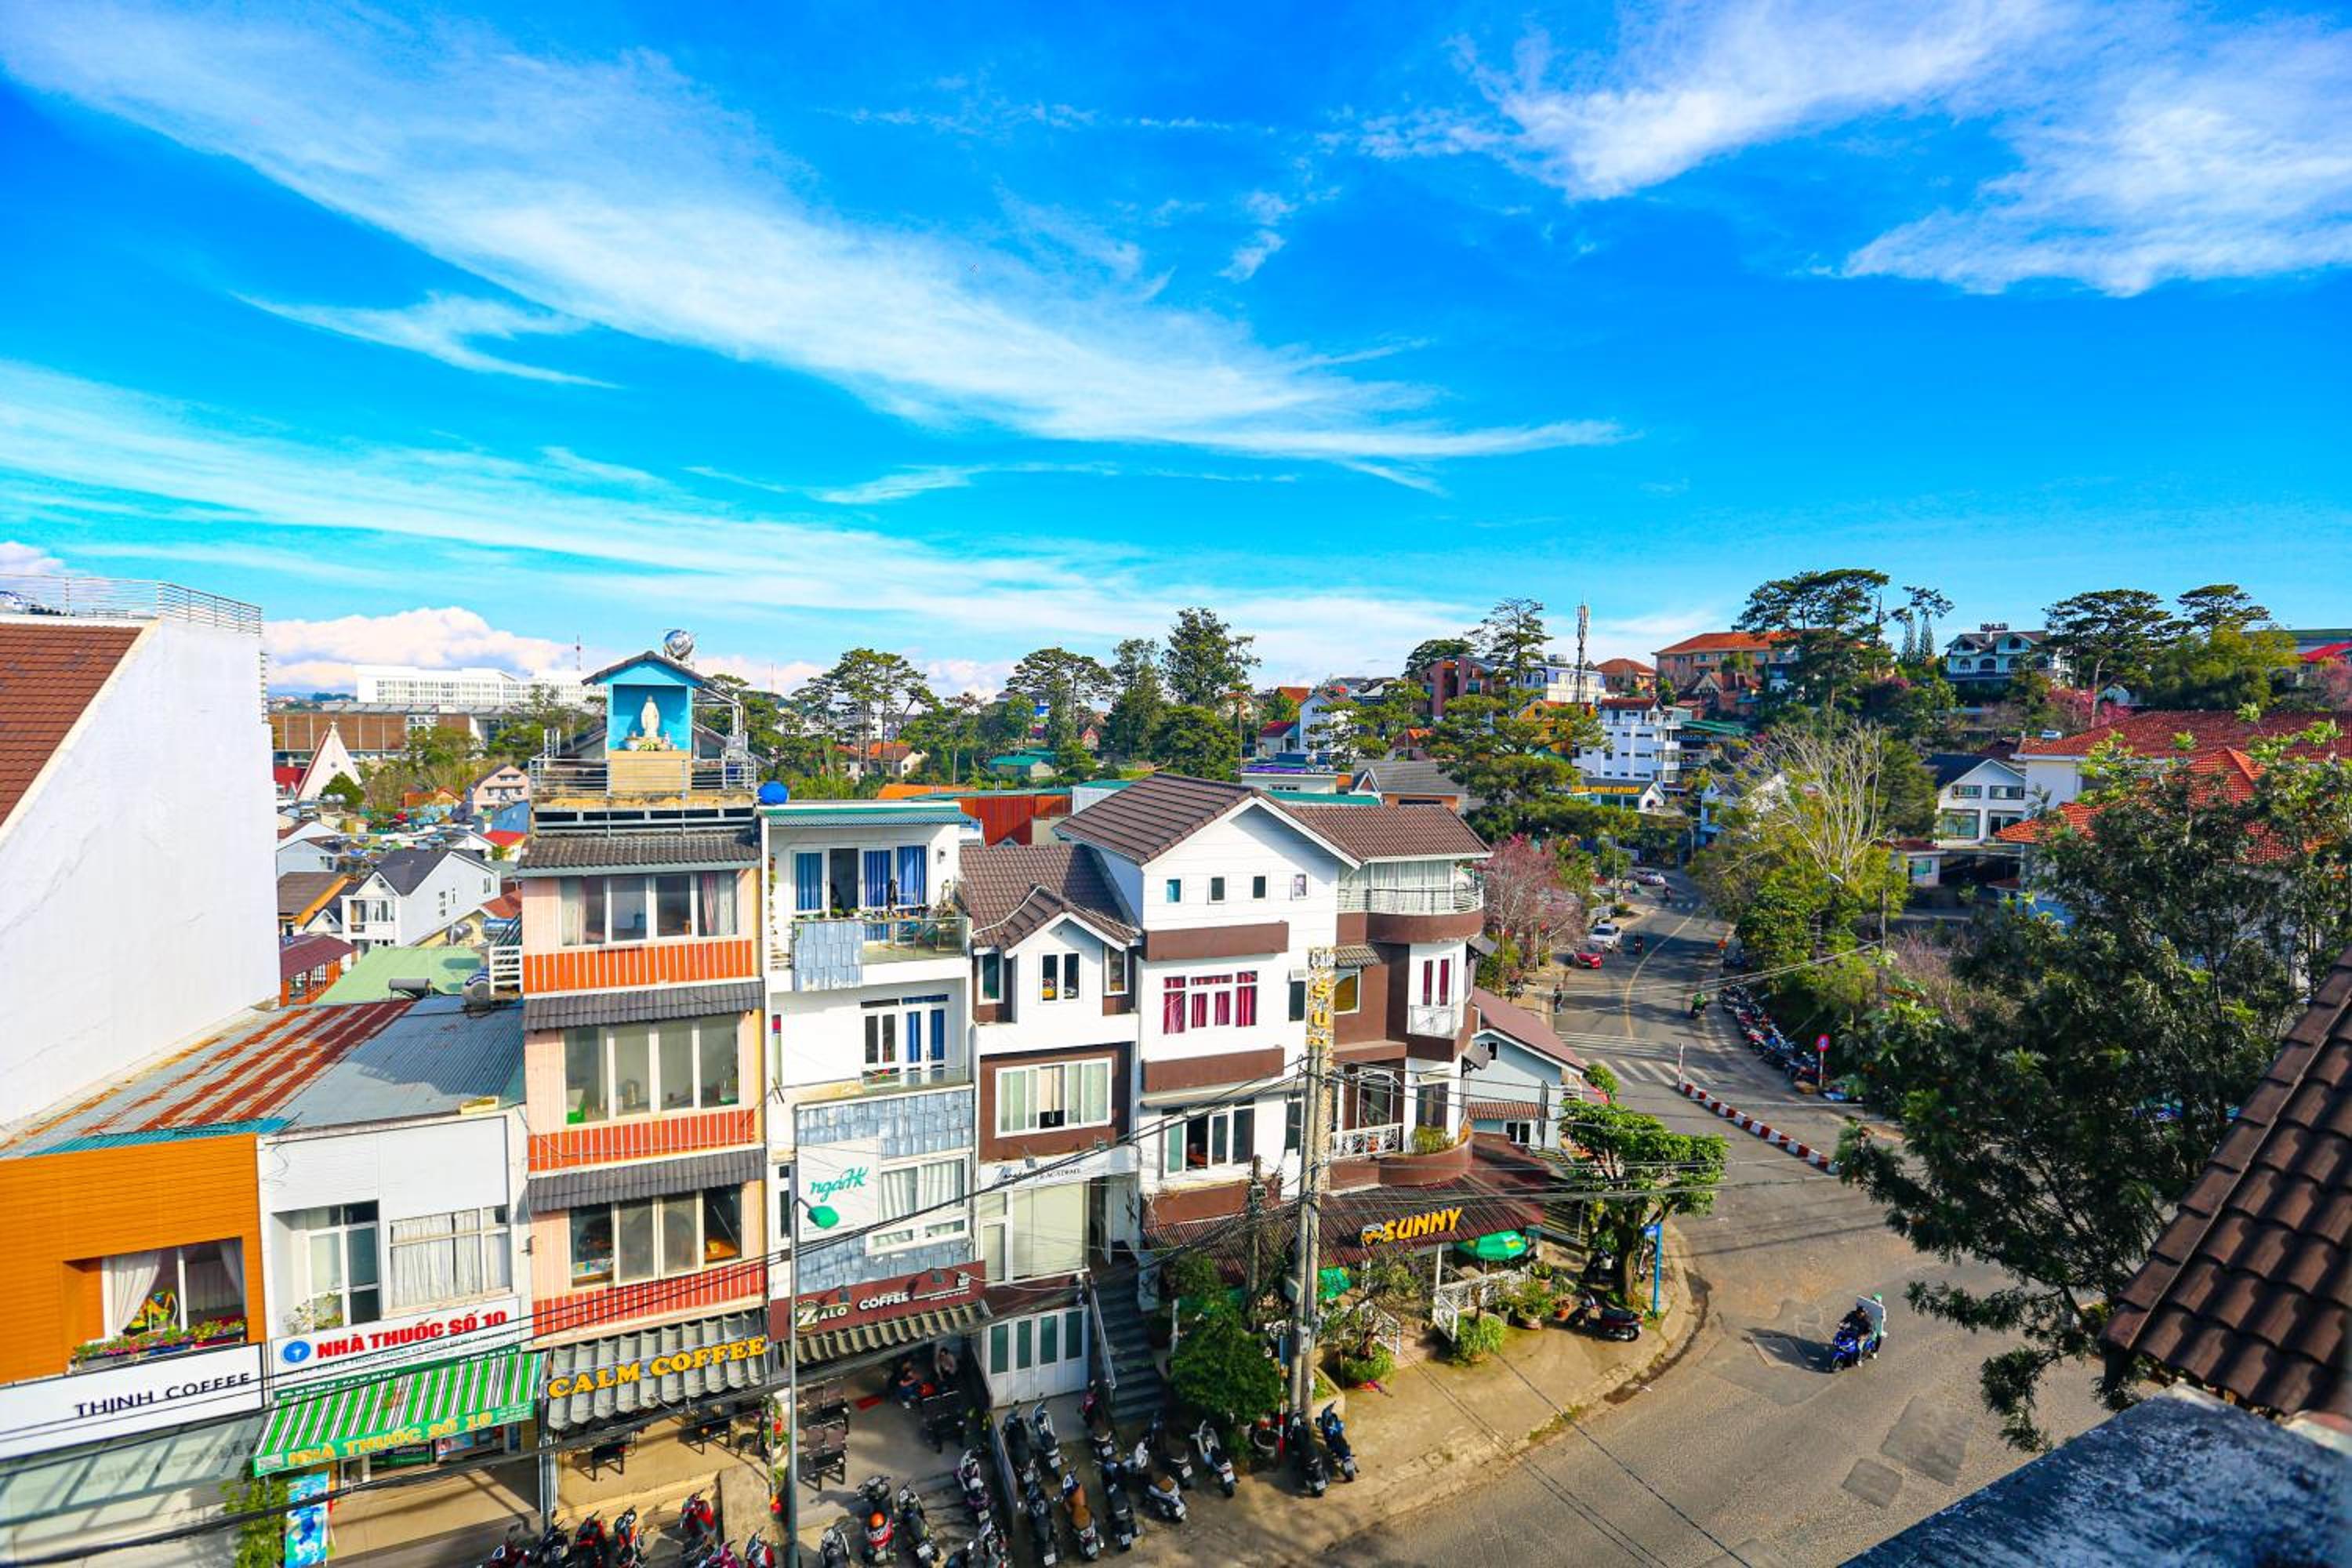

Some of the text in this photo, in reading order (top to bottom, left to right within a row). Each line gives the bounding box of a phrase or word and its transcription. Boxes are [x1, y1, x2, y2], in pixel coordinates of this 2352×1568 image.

[1382, 1207, 1463, 1243] SUNNY
[859, 1292, 910, 1311] COFFEE
[317, 1334, 365, 1359] NHÀ
[368, 1318, 444, 1349] THUỐC
[448, 1309, 479, 1335] SỐ
[481, 1310, 507, 1328] 10
[548, 1336, 767, 1399] CALM COFFEE
[75, 1373, 250, 1418] THỊNH COFFEE
[343, 1425, 422, 1456] THUỐC
[466, 1411, 493, 1431] 10
